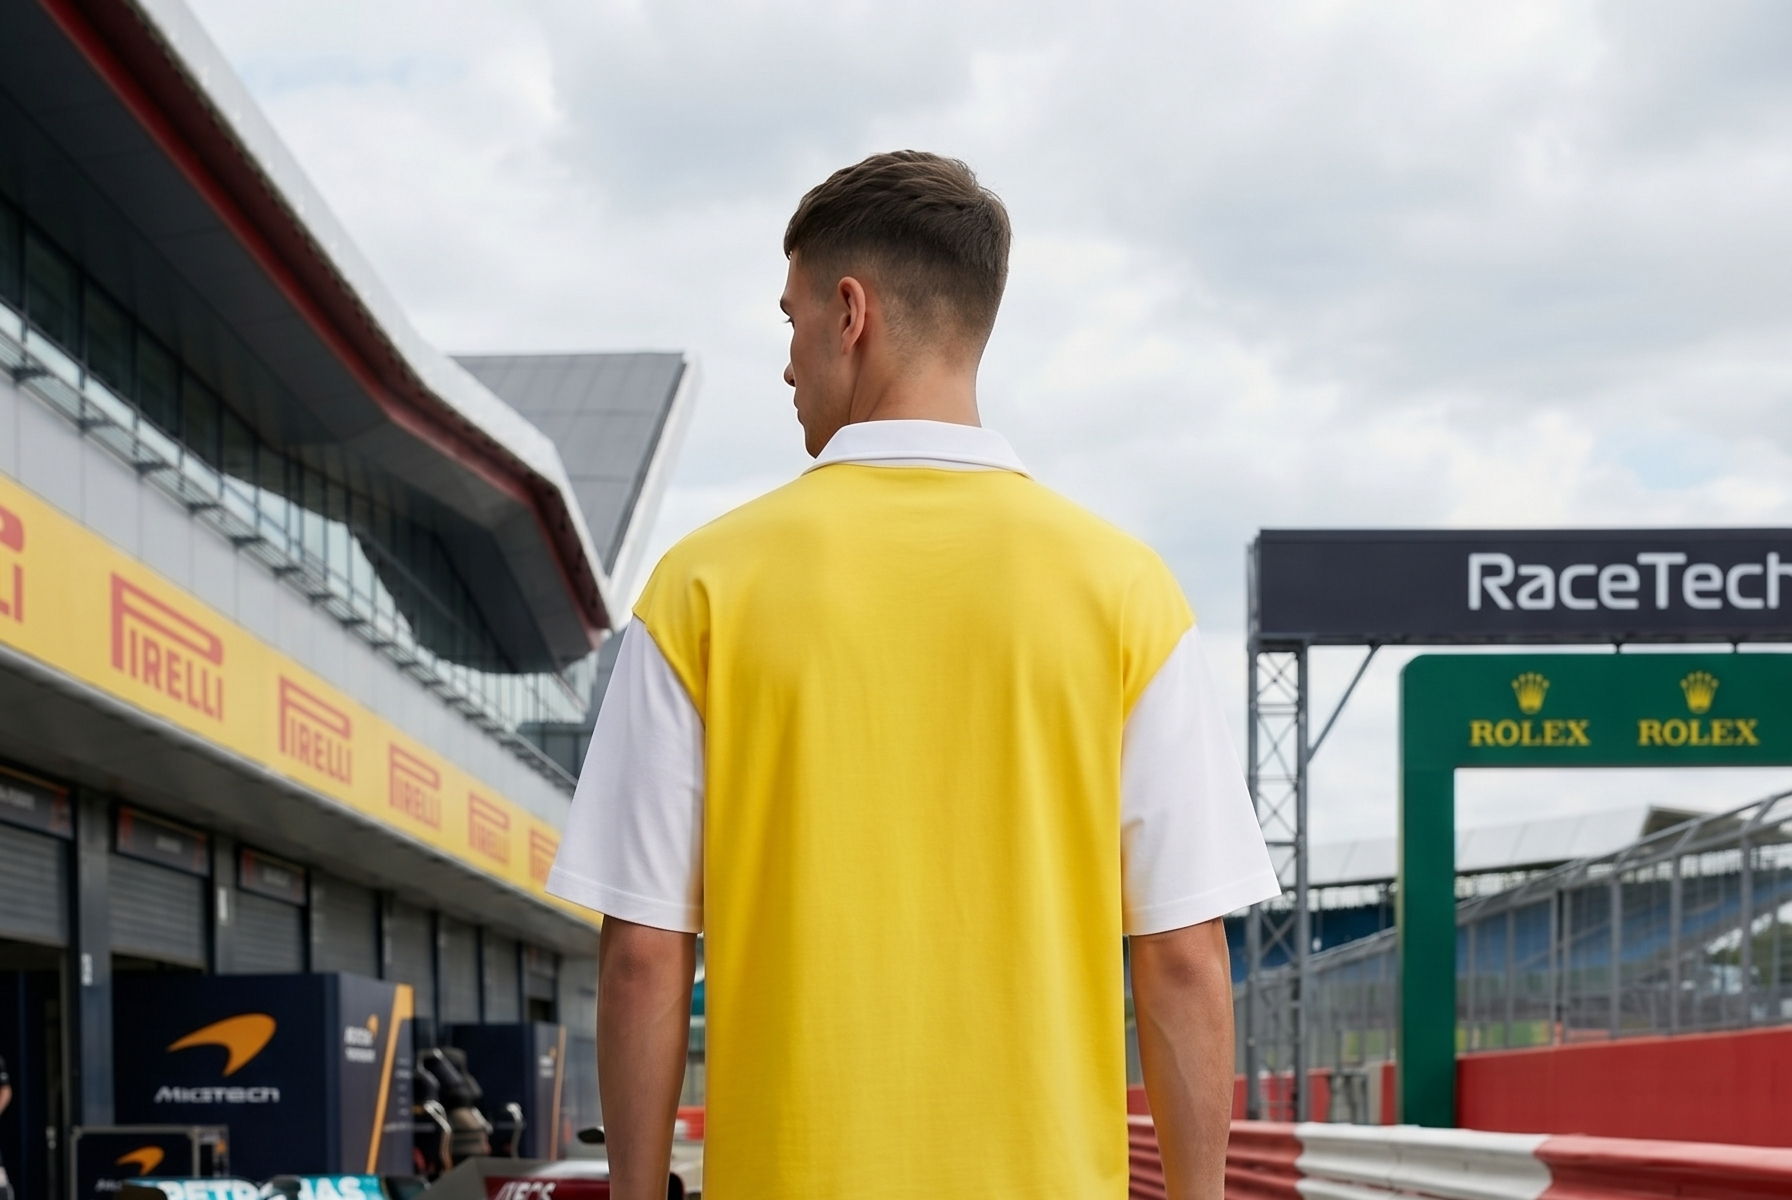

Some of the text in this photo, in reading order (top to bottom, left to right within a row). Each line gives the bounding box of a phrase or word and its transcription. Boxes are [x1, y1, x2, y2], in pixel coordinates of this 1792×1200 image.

[1468, 552, 1792, 610] RaceTech
[110, 571, 224, 723] PIRELLI
[279, 674, 352, 787] PIRELLI
[1469, 719, 1591, 747] ROLEX
[1637, 718, 1760, 746] ROLEX
